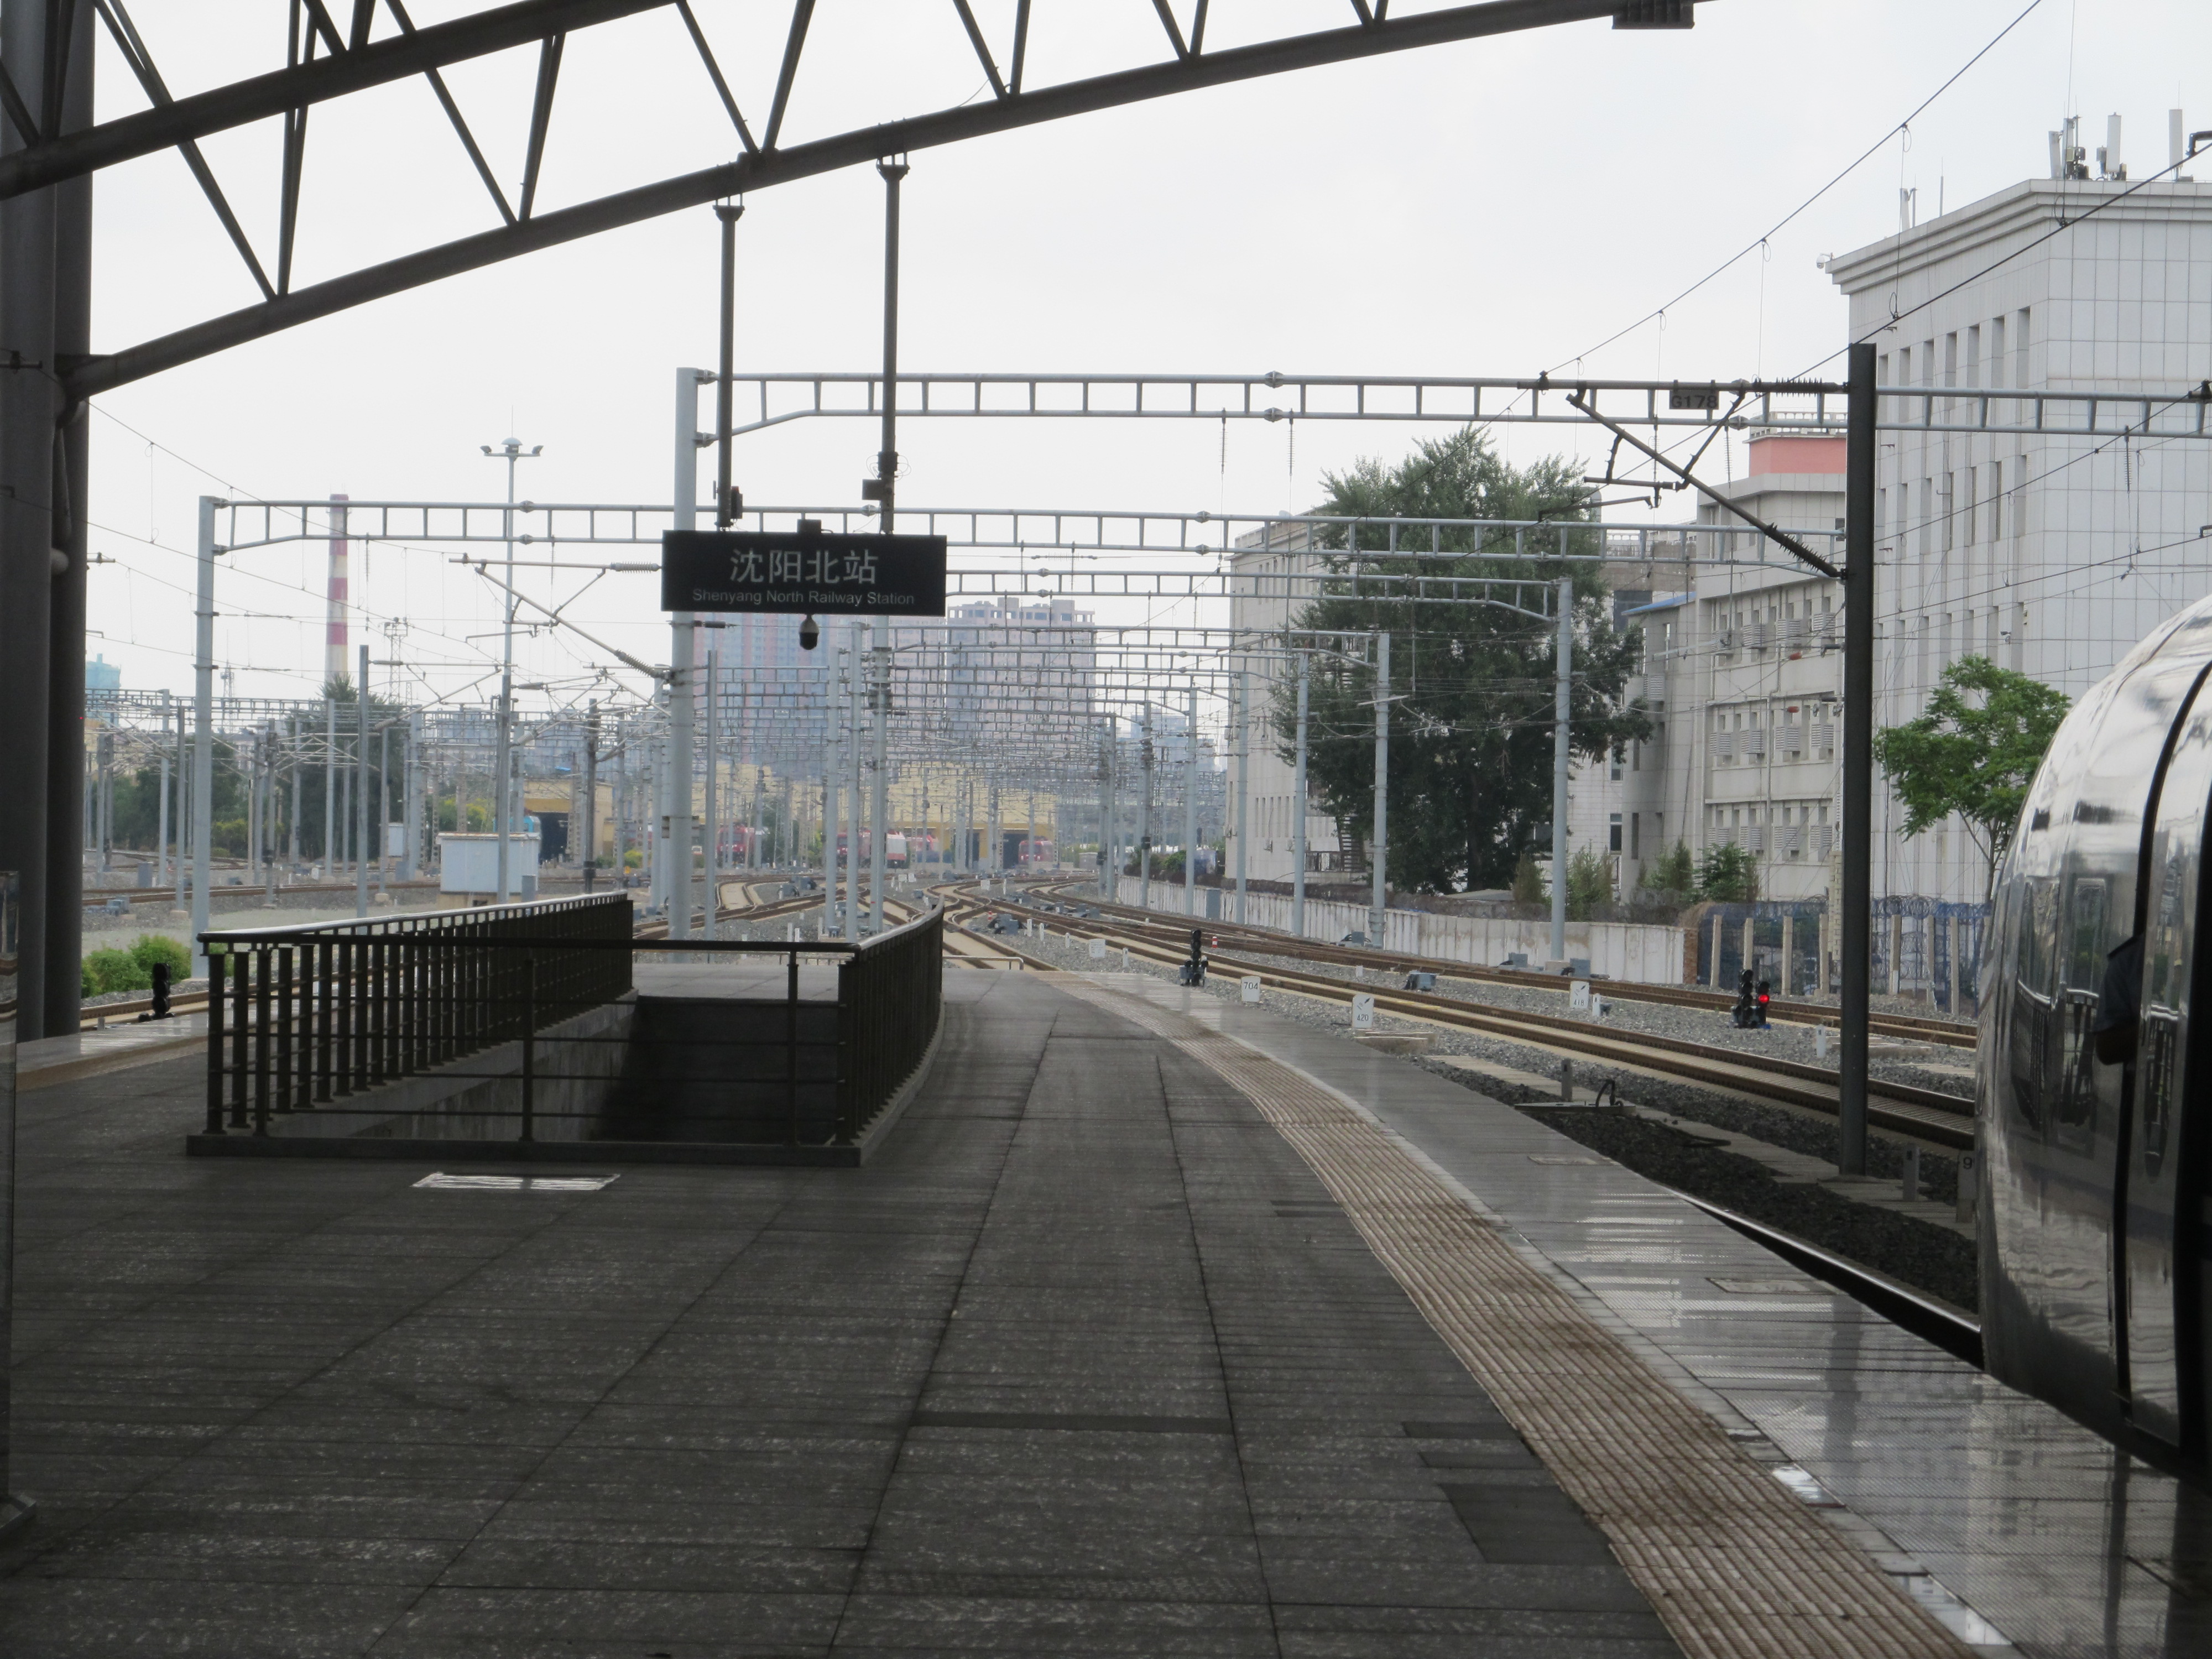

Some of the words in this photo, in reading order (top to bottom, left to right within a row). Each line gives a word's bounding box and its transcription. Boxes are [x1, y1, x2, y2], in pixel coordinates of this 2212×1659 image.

[1671, 394, 1718, 409] G178
[730, 548, 878, 585] 沈阳北站
[693, 589, 761, 605] Shenyang
[766, 590, 804, 602] North
[808, 591, 863, 607] Railway
[867, 592, 914, 604] Station
[1244, 982, 1259, 990] 704
